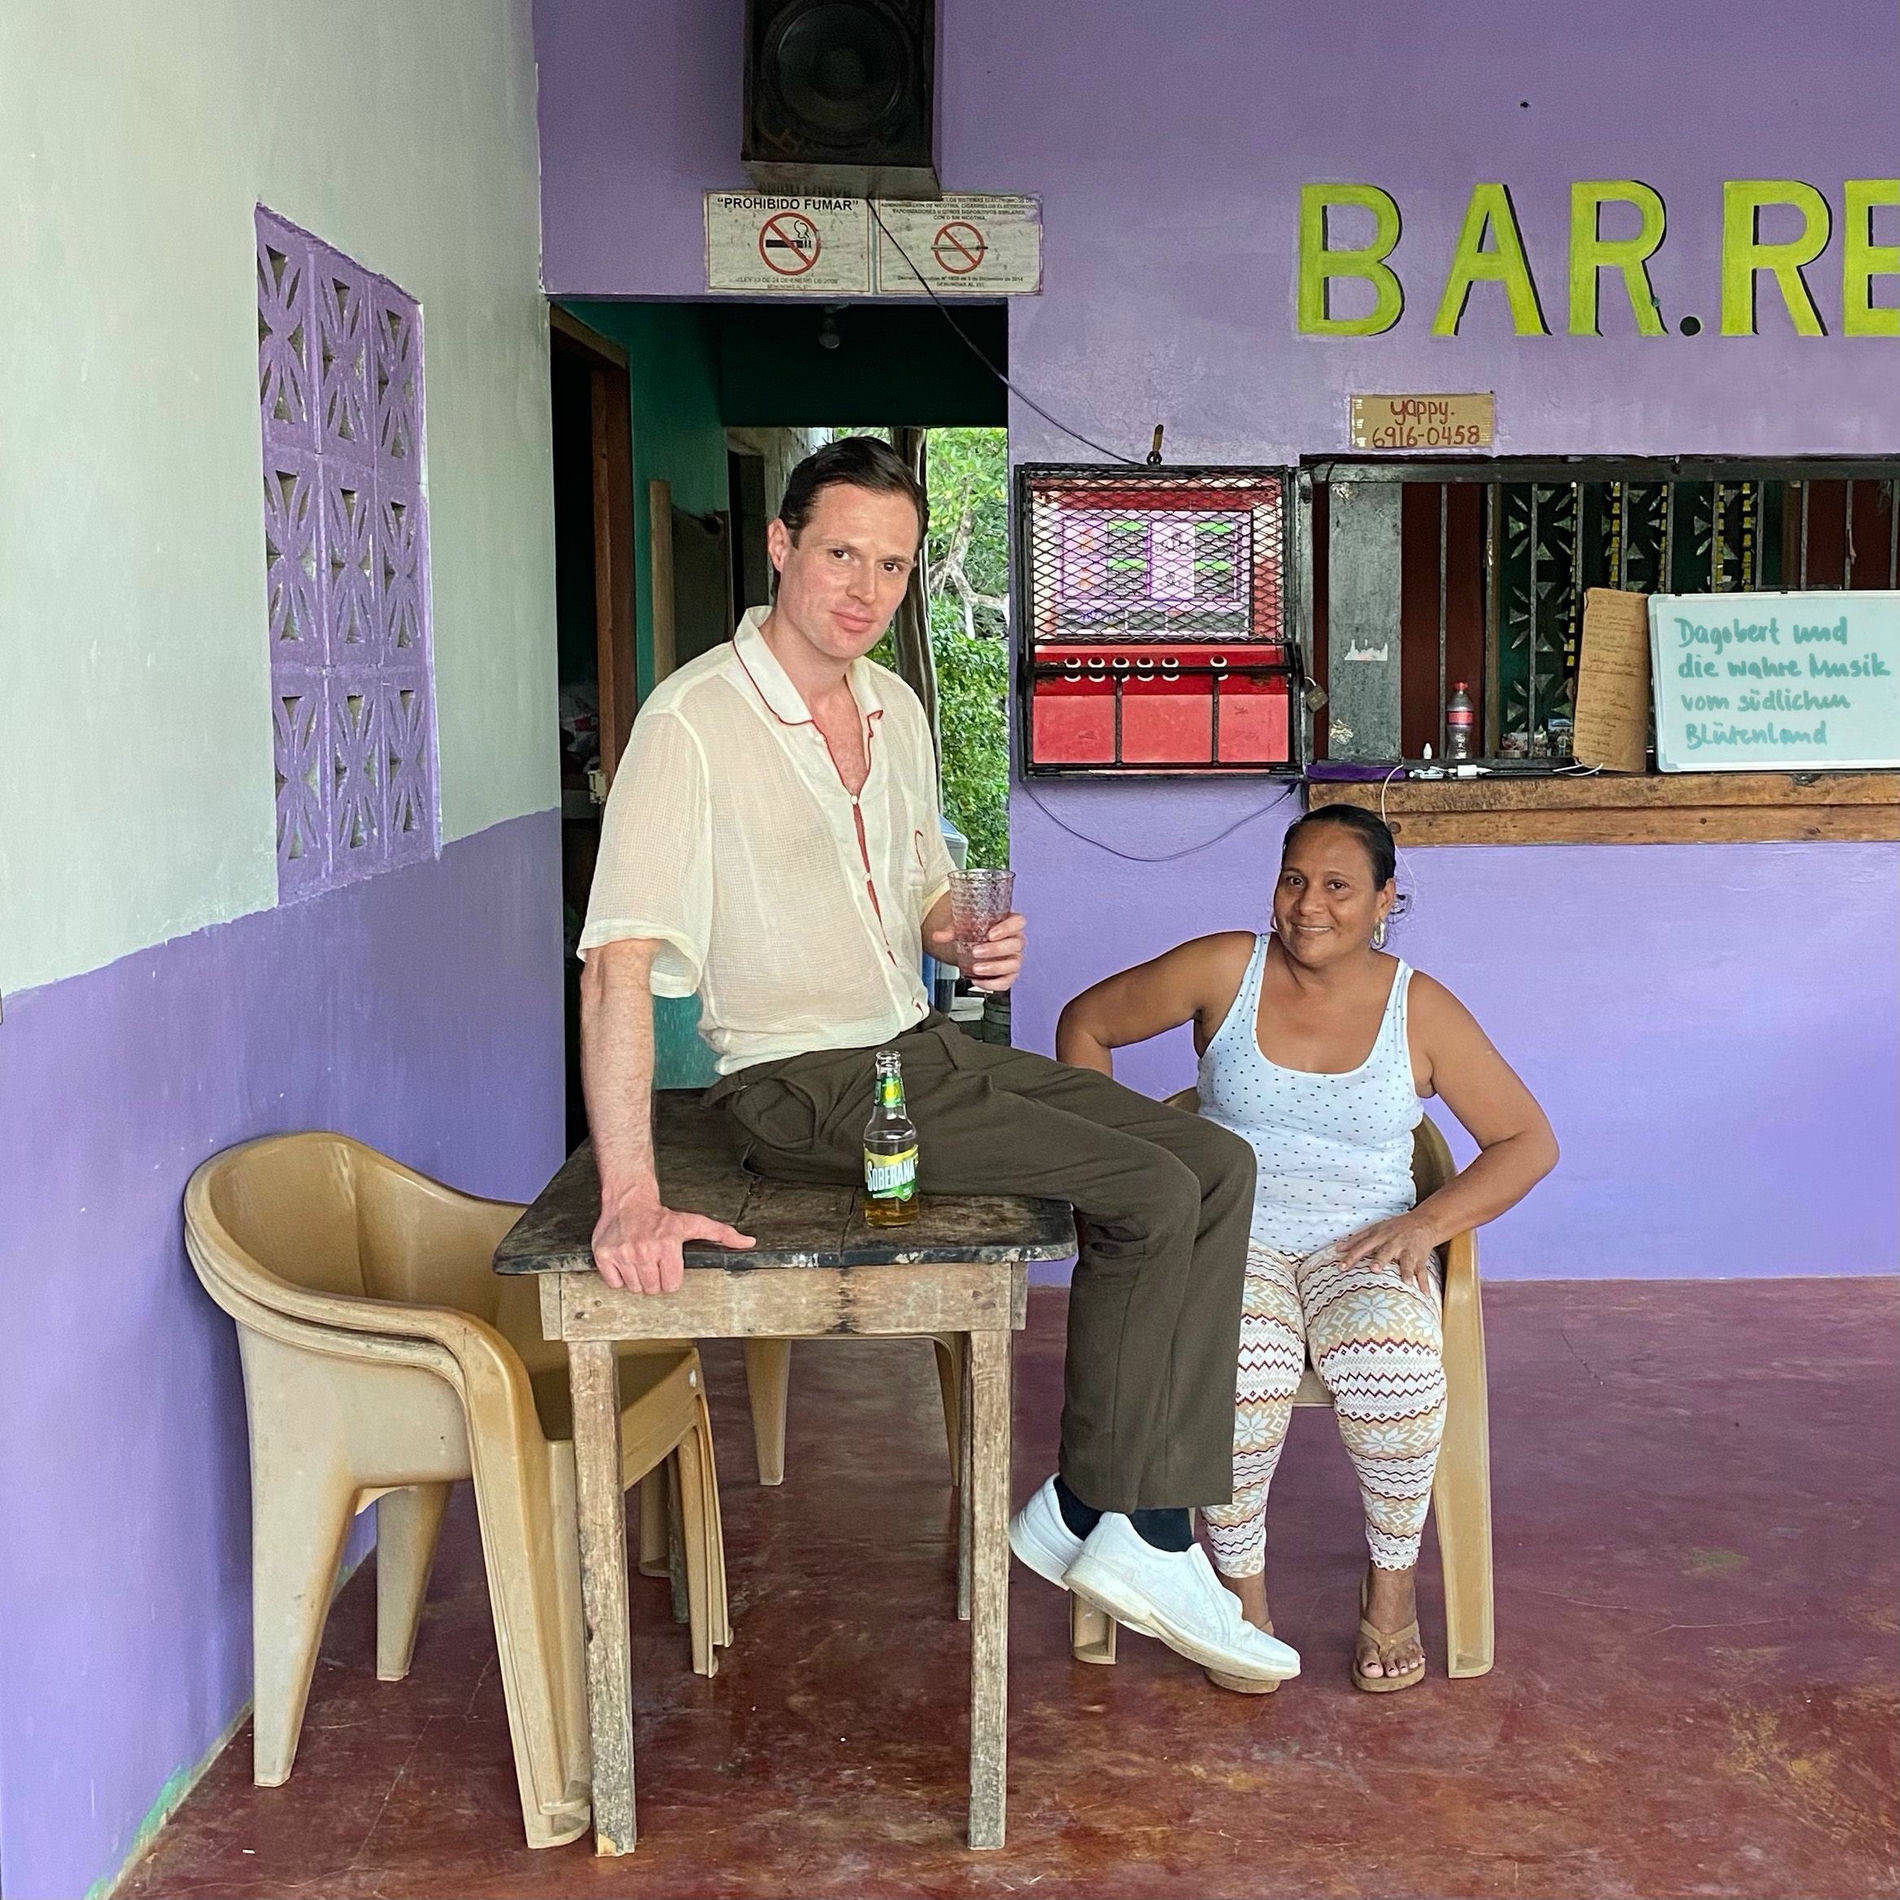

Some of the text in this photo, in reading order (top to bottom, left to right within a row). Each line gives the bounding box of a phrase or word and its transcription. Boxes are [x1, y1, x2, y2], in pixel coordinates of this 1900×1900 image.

[1372, 425, 1480, 448] 6916-0458
[1674, 615, 1848, 655] Dagobert und
[1678, 652, 1720, 679] die
[1728, 656, 1803, 680] wahre
[1681, 689, 1851, 713] vom südlichen
[867, 1157, 916, 1191] SOBERANA
